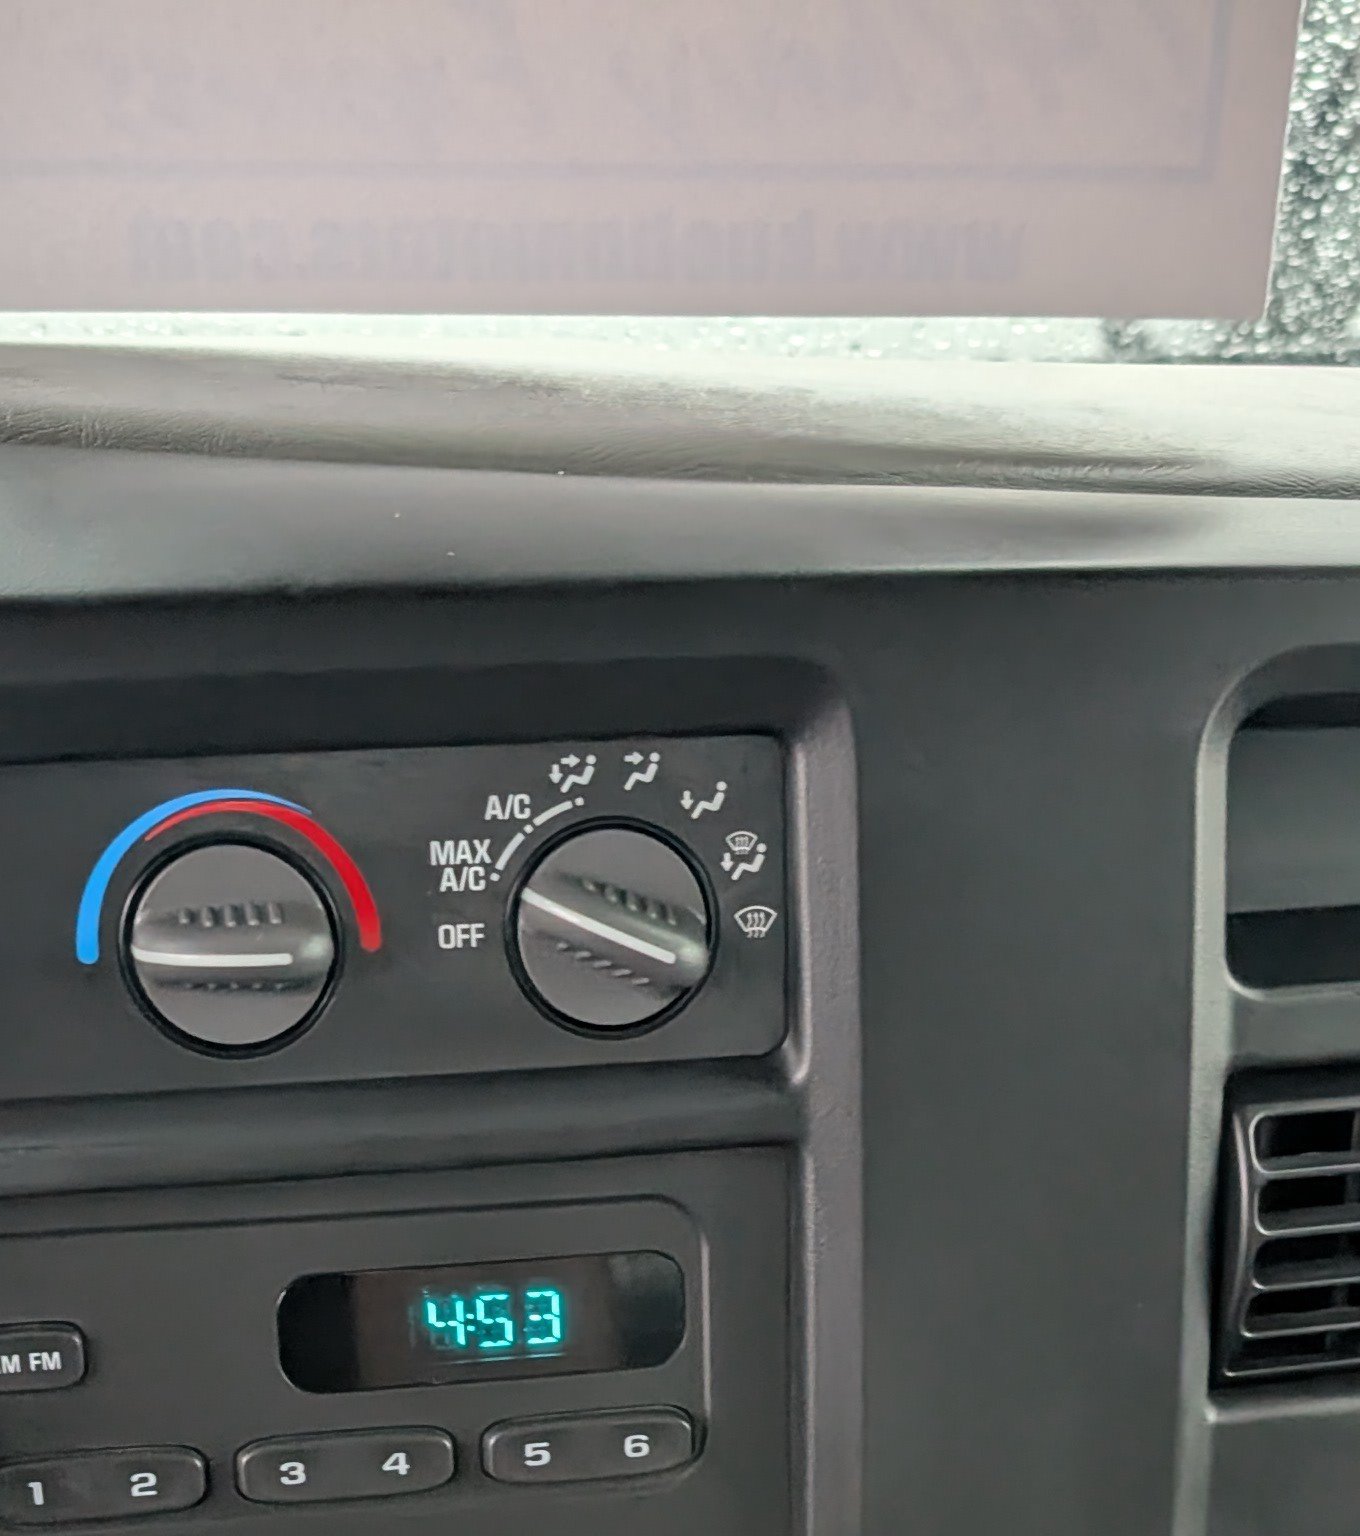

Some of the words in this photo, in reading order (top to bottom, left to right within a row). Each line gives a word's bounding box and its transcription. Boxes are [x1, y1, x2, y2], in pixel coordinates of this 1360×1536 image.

[485, 794, 531, 820] A/C
[429, 839, 491, 866] MAX
[439, 866, 486, 892] A/C
[437, 923, 485, 949] OFF
[426, 1290, 561, 1348] 4:53
[28, 1351, 62, 1372] FM
[524, 1442, 551, 1467] 5
[623, 1434, 650, 1459] 6
[279, 1462, 306, 1486] 3
[381, 1452, 410, 1476] 4
[27, 1481, 44, 1506] 1
[129, 1472, 158, 1497] 2
